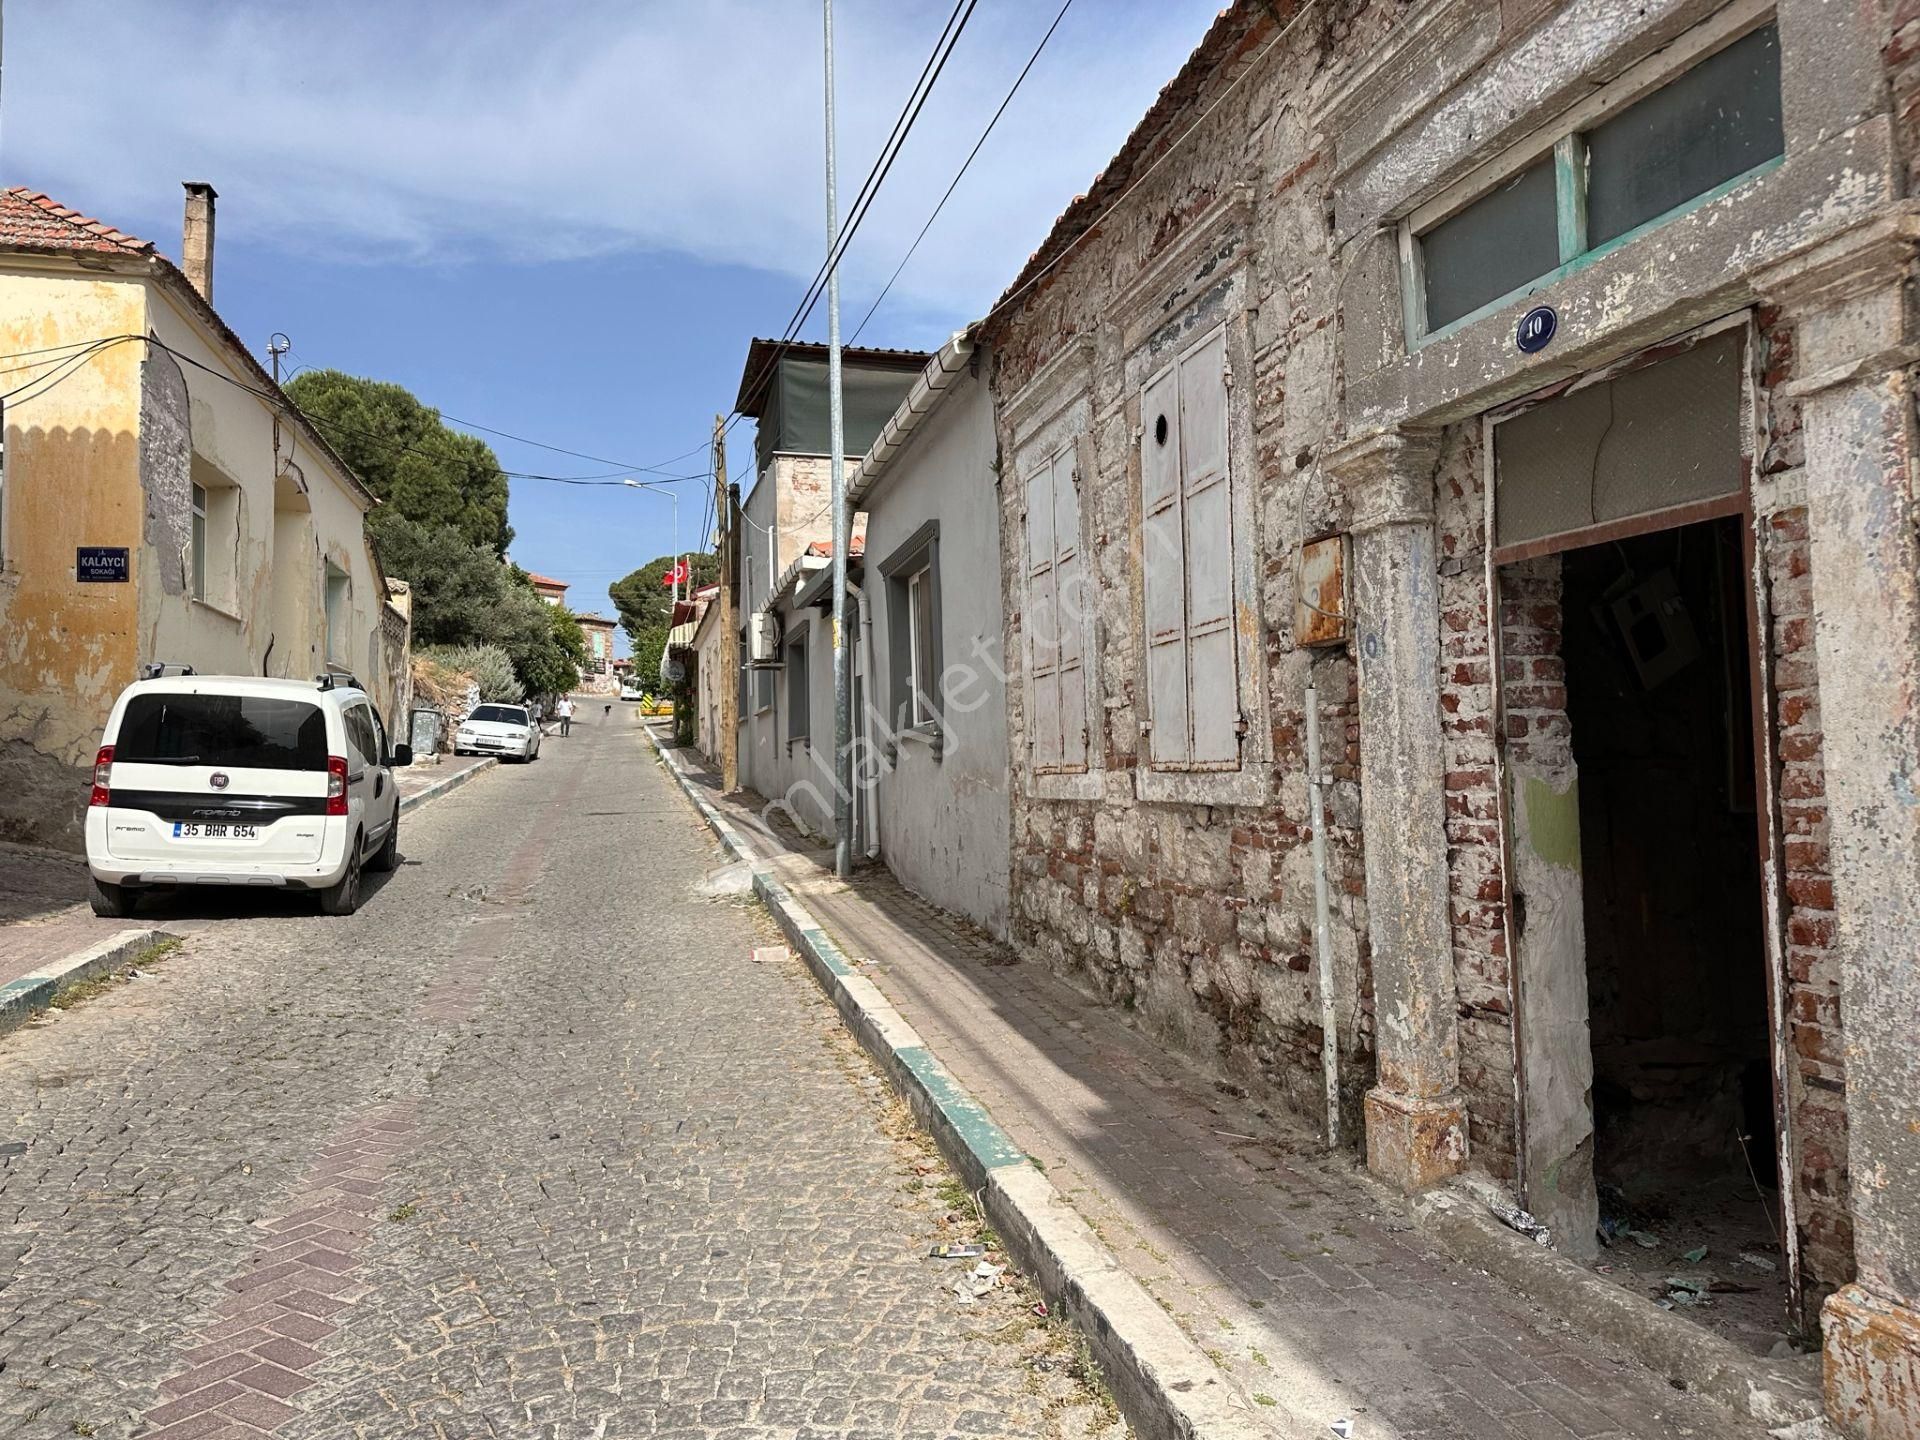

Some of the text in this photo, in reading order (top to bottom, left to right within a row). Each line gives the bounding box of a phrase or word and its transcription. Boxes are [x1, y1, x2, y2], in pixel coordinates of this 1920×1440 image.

[1526, 316, 1543, 339] 10
[81, 557, 124, 567] KALAYCI
[184, 823, 199, 836] 35
[204, 824, 228, 837] BHR
[233, 825, 256, 838] 654
